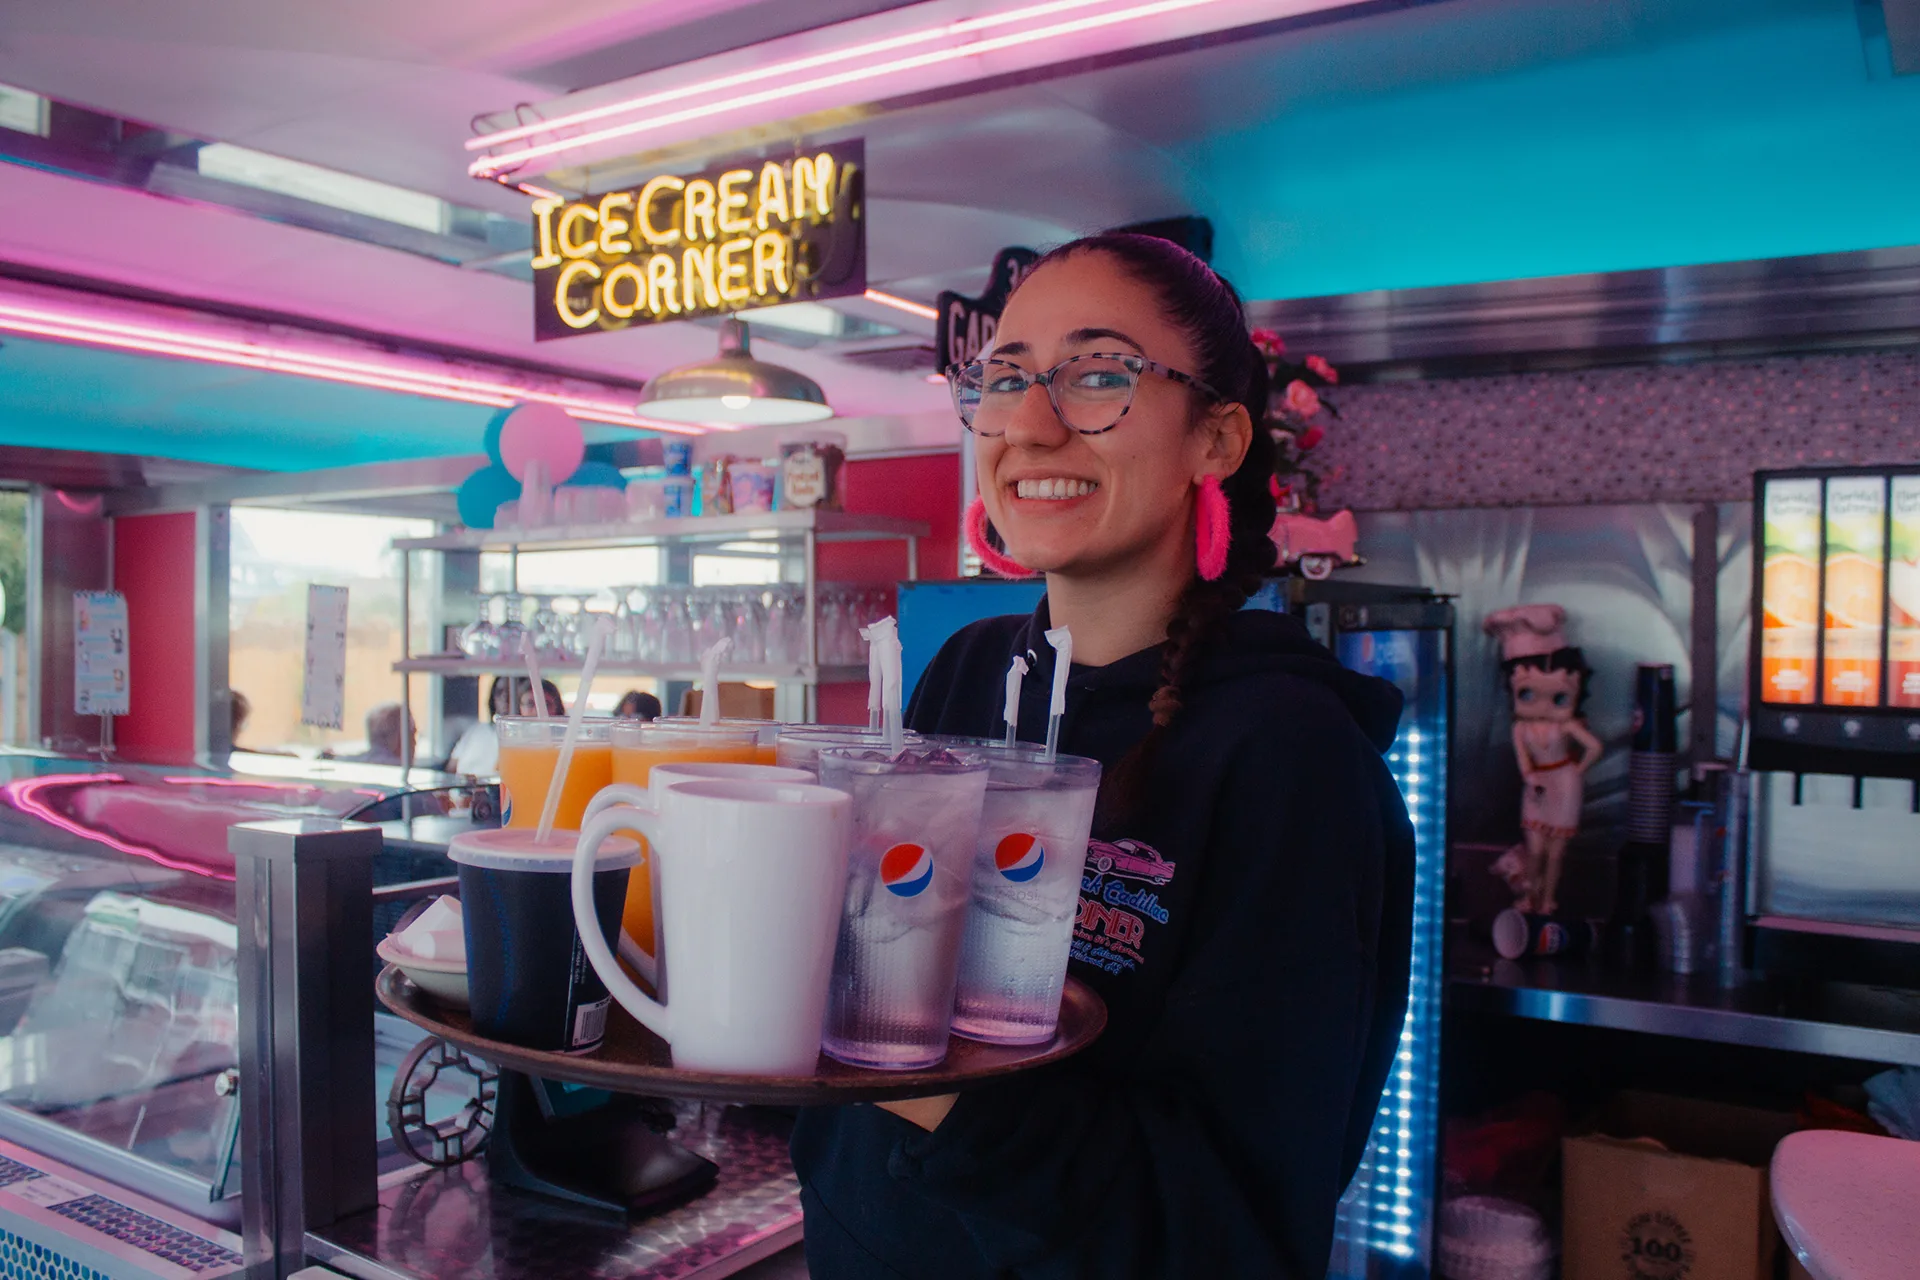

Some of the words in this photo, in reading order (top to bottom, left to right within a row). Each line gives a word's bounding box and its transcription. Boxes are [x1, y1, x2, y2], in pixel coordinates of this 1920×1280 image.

[555, 230, 791, 329] CORNER
[1103, 880, 1170, 925] Cadillac
[1631, 1237, 1682, 1262] 100
